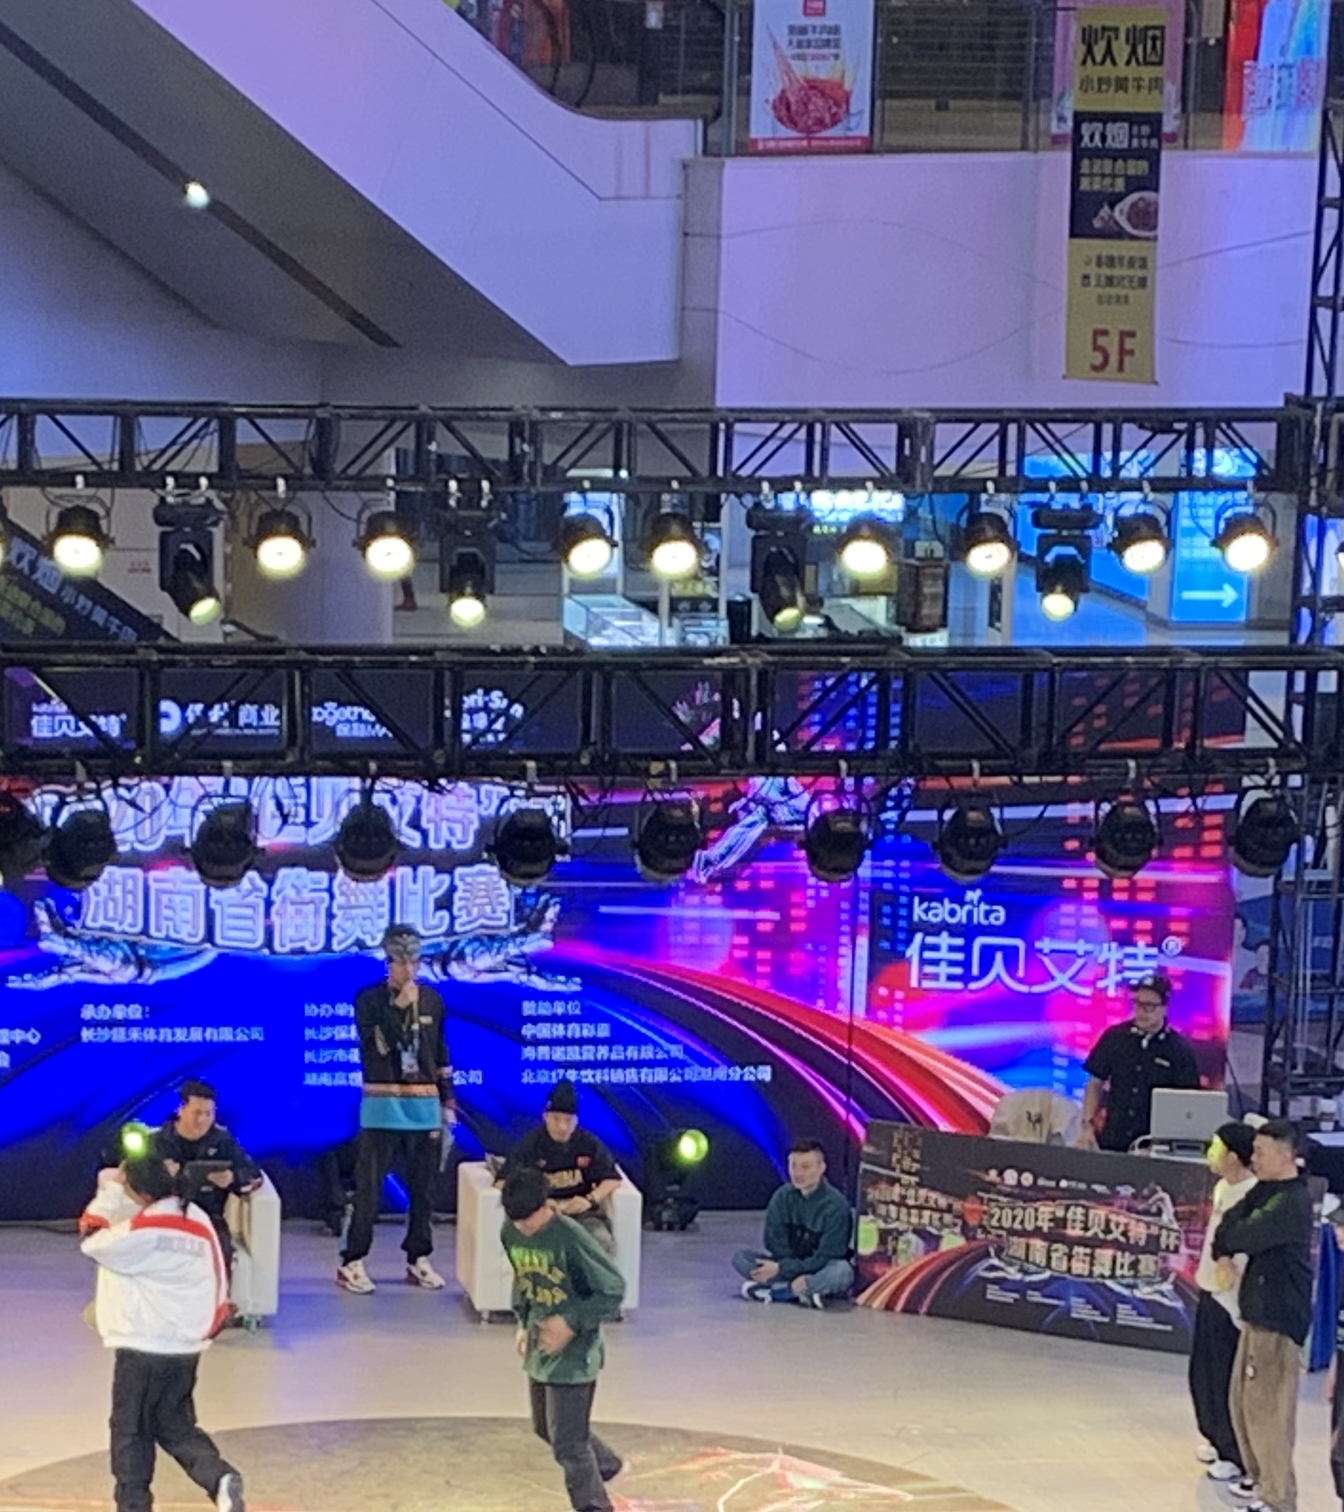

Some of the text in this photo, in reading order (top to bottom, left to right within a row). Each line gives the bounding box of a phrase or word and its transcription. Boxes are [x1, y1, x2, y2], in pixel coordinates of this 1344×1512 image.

[1080, 24, 1166, 67] 炊烟
[1081, 121, 1130, 149] 炊烟
[1090, 327, 1138, 373] 5F
[80, 864, 511, 952] 湖南省街舞比赛
[911, 895, 1006, 927] kabrita
[906, 930, 1159, 998] 佳贝艾特
